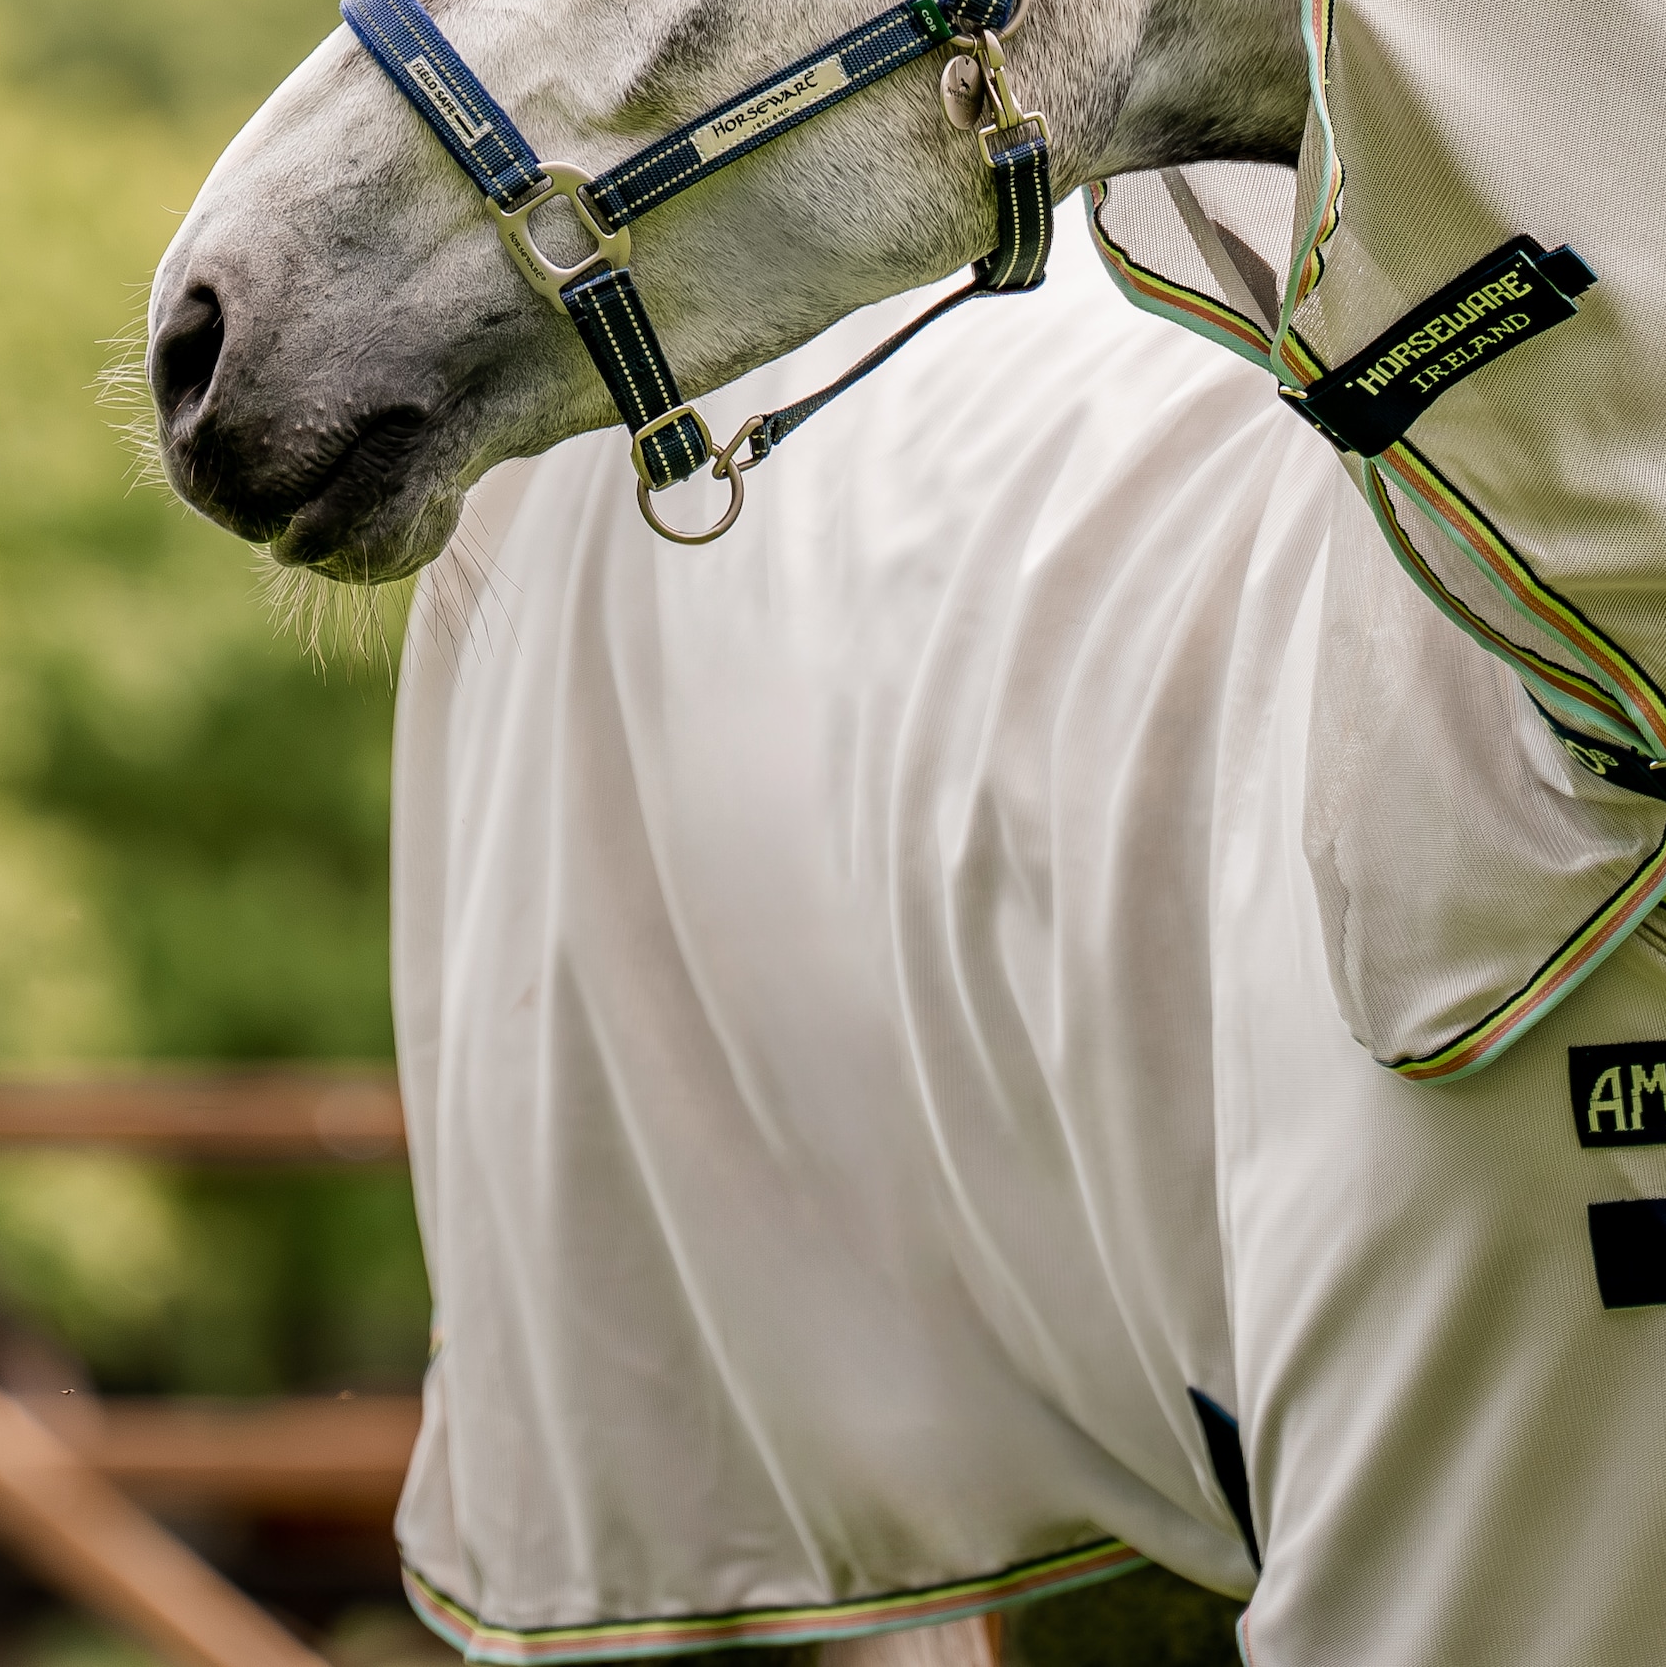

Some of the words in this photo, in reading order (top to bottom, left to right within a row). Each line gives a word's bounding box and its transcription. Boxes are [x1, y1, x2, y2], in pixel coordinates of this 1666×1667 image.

[921, 9, 937, 32] COB
[413, 62, 437, 90] FIELD
[434, 90, 457, 115] SAFE
[711, 70, 819, 138] HORSEWARE
[1409, 313, 1531, 393] IRELAND
